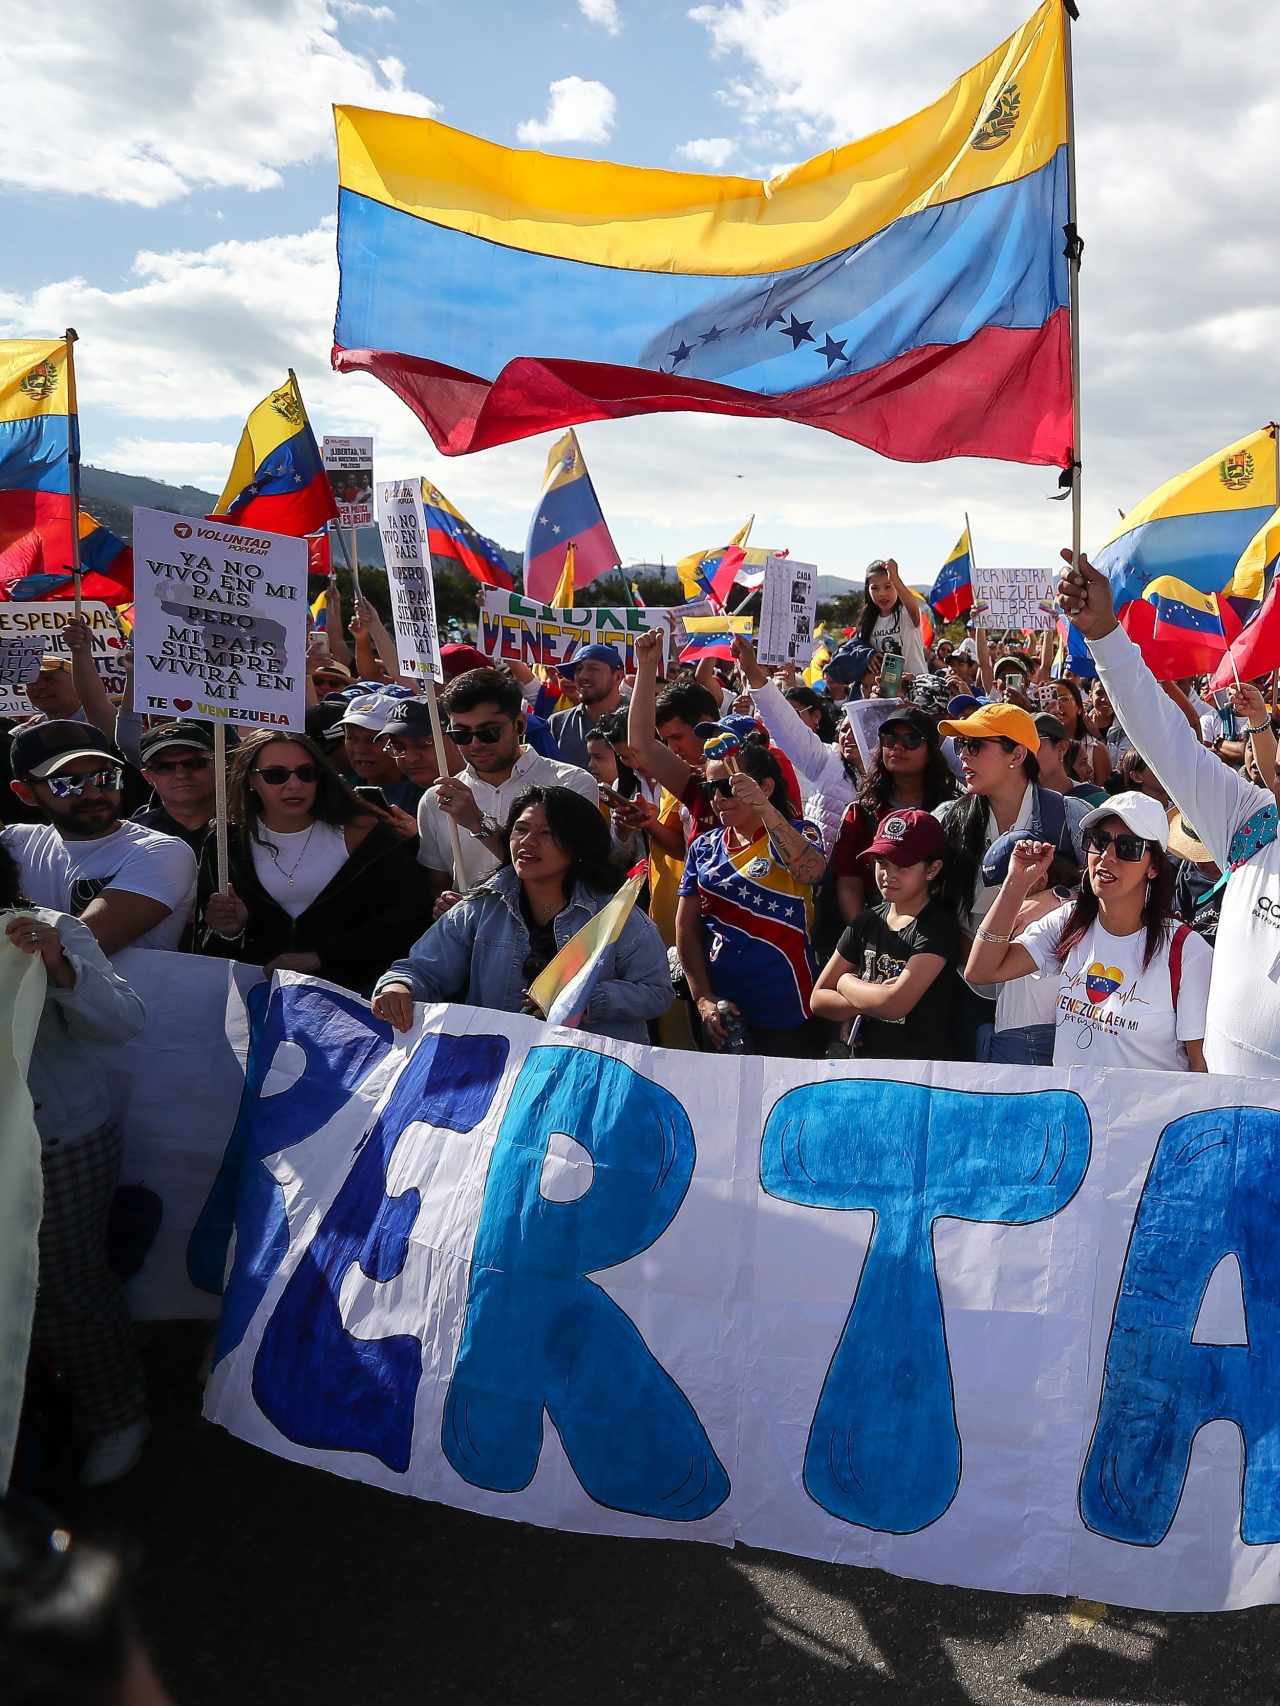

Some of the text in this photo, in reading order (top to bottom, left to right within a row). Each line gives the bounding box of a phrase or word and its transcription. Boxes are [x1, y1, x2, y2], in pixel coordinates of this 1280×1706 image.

[387, 515, 417, 529] YA NO
[197, 528, 271, 549] VOLUNTAD
[401, 530, 416, 544] EN
[228, 544, 268, 556] POPULAR
[180, 551, 264, 580] YA NO
[146, 560, 298, 601] VIVO EN MI
[796, 571, 811, 580] CADA
[976, 568, 1046, 583] POR NUESTRA
[972, 585, 1055, 600] VENEZUELA
[790, 603, 803, 613] VIDA
[991, 601, 1037, 615] LIBRE
[188, 606, 255, 628] PERO
[974, 615, 1055, 628] HASTA EL FINAL
[168, 625, 275, 656] MI PAÍS
[790, 633, 810, 643] CUENTA
[414, 639, 431, 653] MI
[161, 640, 283, 675] SIEMPRE
[403, 660, 409, 671] TE
[256, 673, 295, 692] EN
[204, 681, 239, 700] MI
[147, 696, 290, 725] TE VENEZUELA
[1055, 994, 1139, 1032] VENEZUELA EN MI
